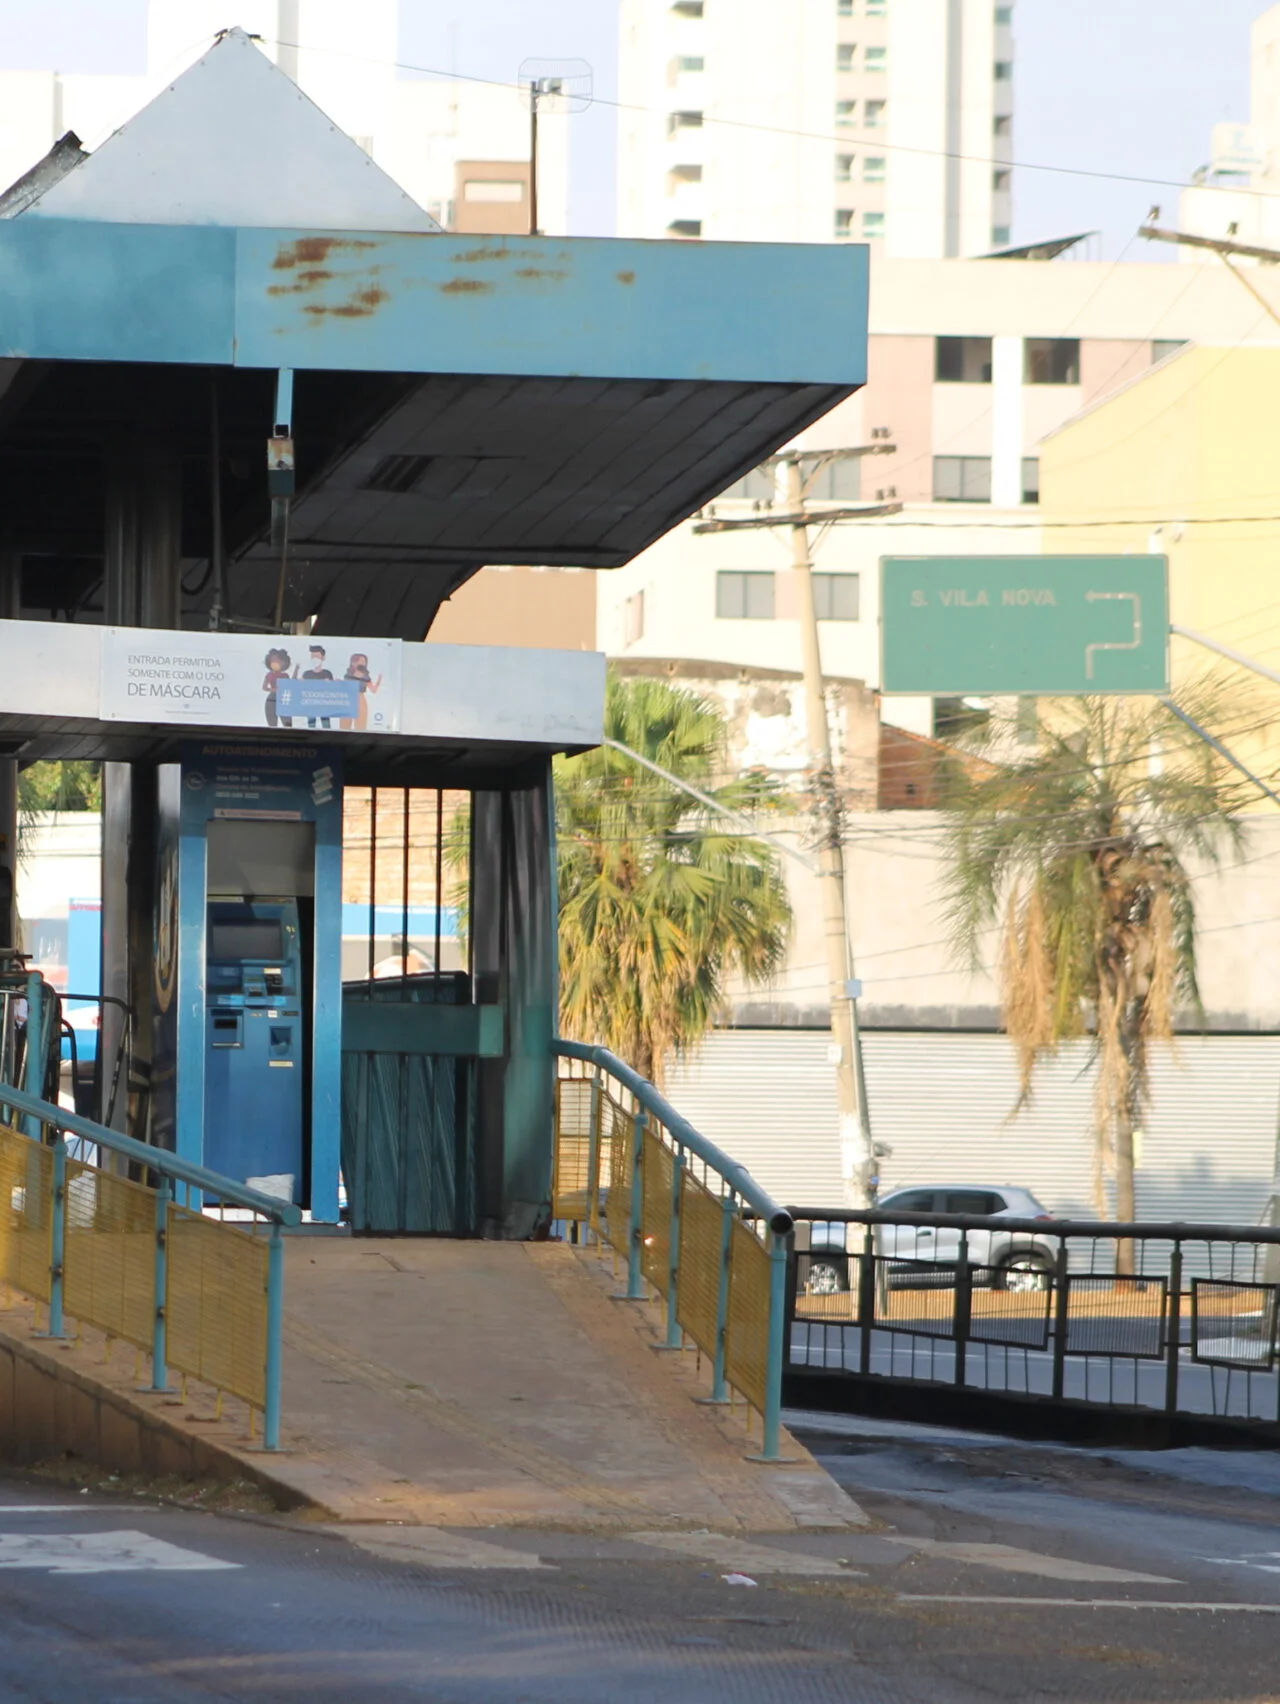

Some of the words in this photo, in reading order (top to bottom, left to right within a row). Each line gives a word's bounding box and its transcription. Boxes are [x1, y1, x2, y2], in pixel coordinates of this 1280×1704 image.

[939, 588, 989, 607] VILA
[1001, 588, 1058, 607] NOVA
[127, 655, 171, 665] ENTRADA
[172, 657, 221, 668] PERMITIDA
[127, 668, 171, 679] SOMENTE
[172, 670, 194, 680] COM
[195, 671, 204, 681] O
[204, 672, 225, 682] USO
[127, 683, 147, 697] DE
[149, 682, 221, 700] MÁSCARA
[202, 745, 318, 758] AUTOATENDIMENTO
